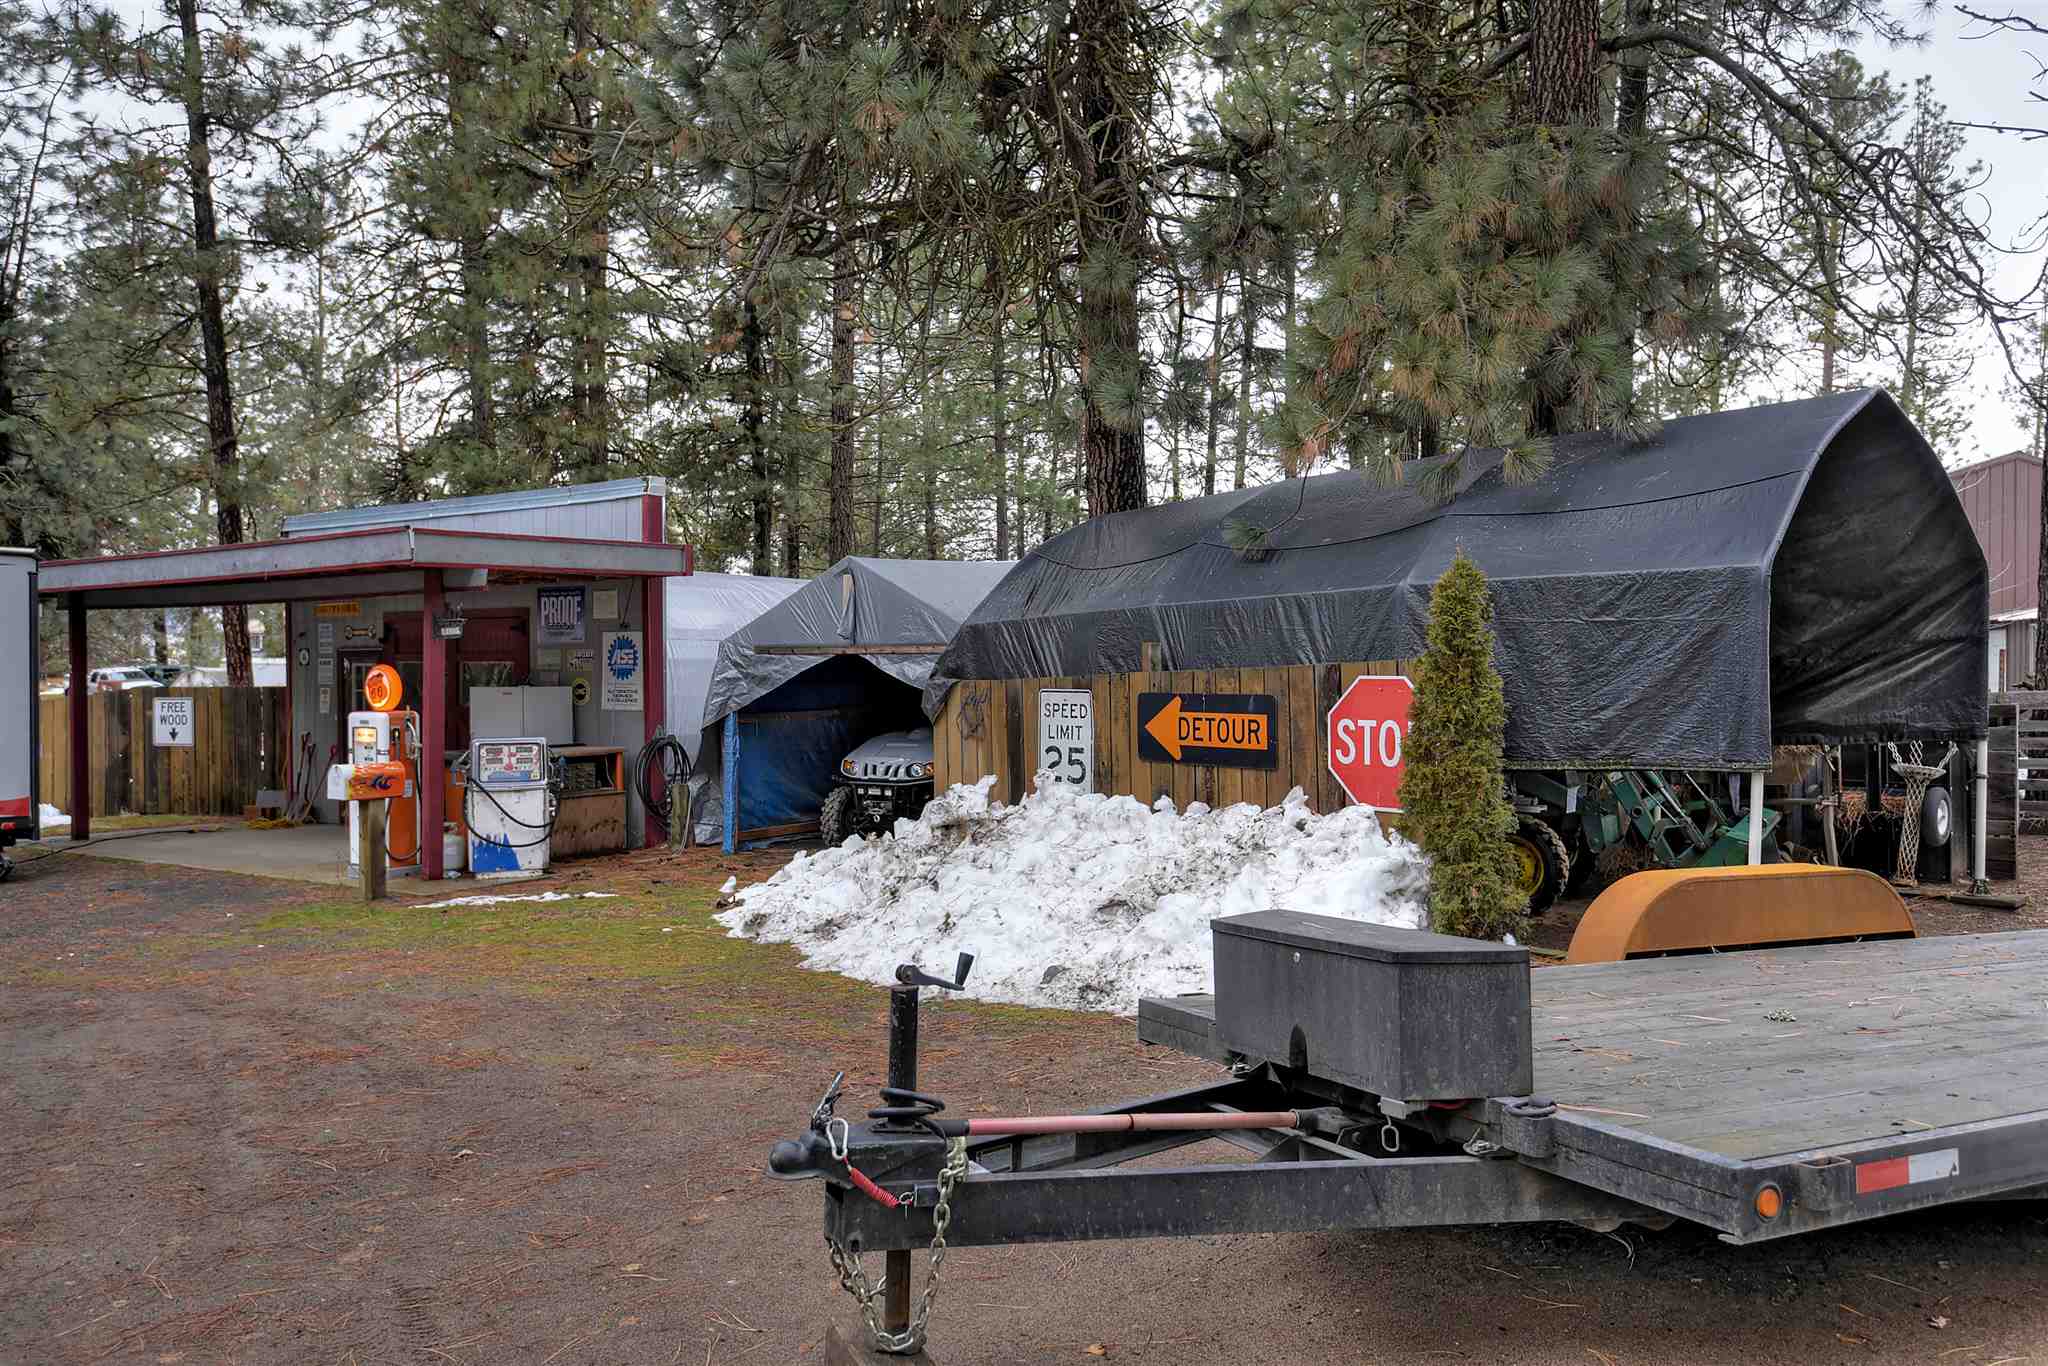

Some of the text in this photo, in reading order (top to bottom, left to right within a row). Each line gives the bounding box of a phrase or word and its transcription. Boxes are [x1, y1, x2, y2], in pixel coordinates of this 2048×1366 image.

[610, 648, 634, 665] ASE
[161, 701, 186, 713] FREE
[1043, 702, 1088, 719] SPEED
[160, 714, 188, 726] WOOD
[1048, 724, 1083, 741] LIMIT
[1178, 715, 1262, 746] DETOUR
[1335, 718, 1412, 768] STO
[1045, 745, 1087, 785] 25
